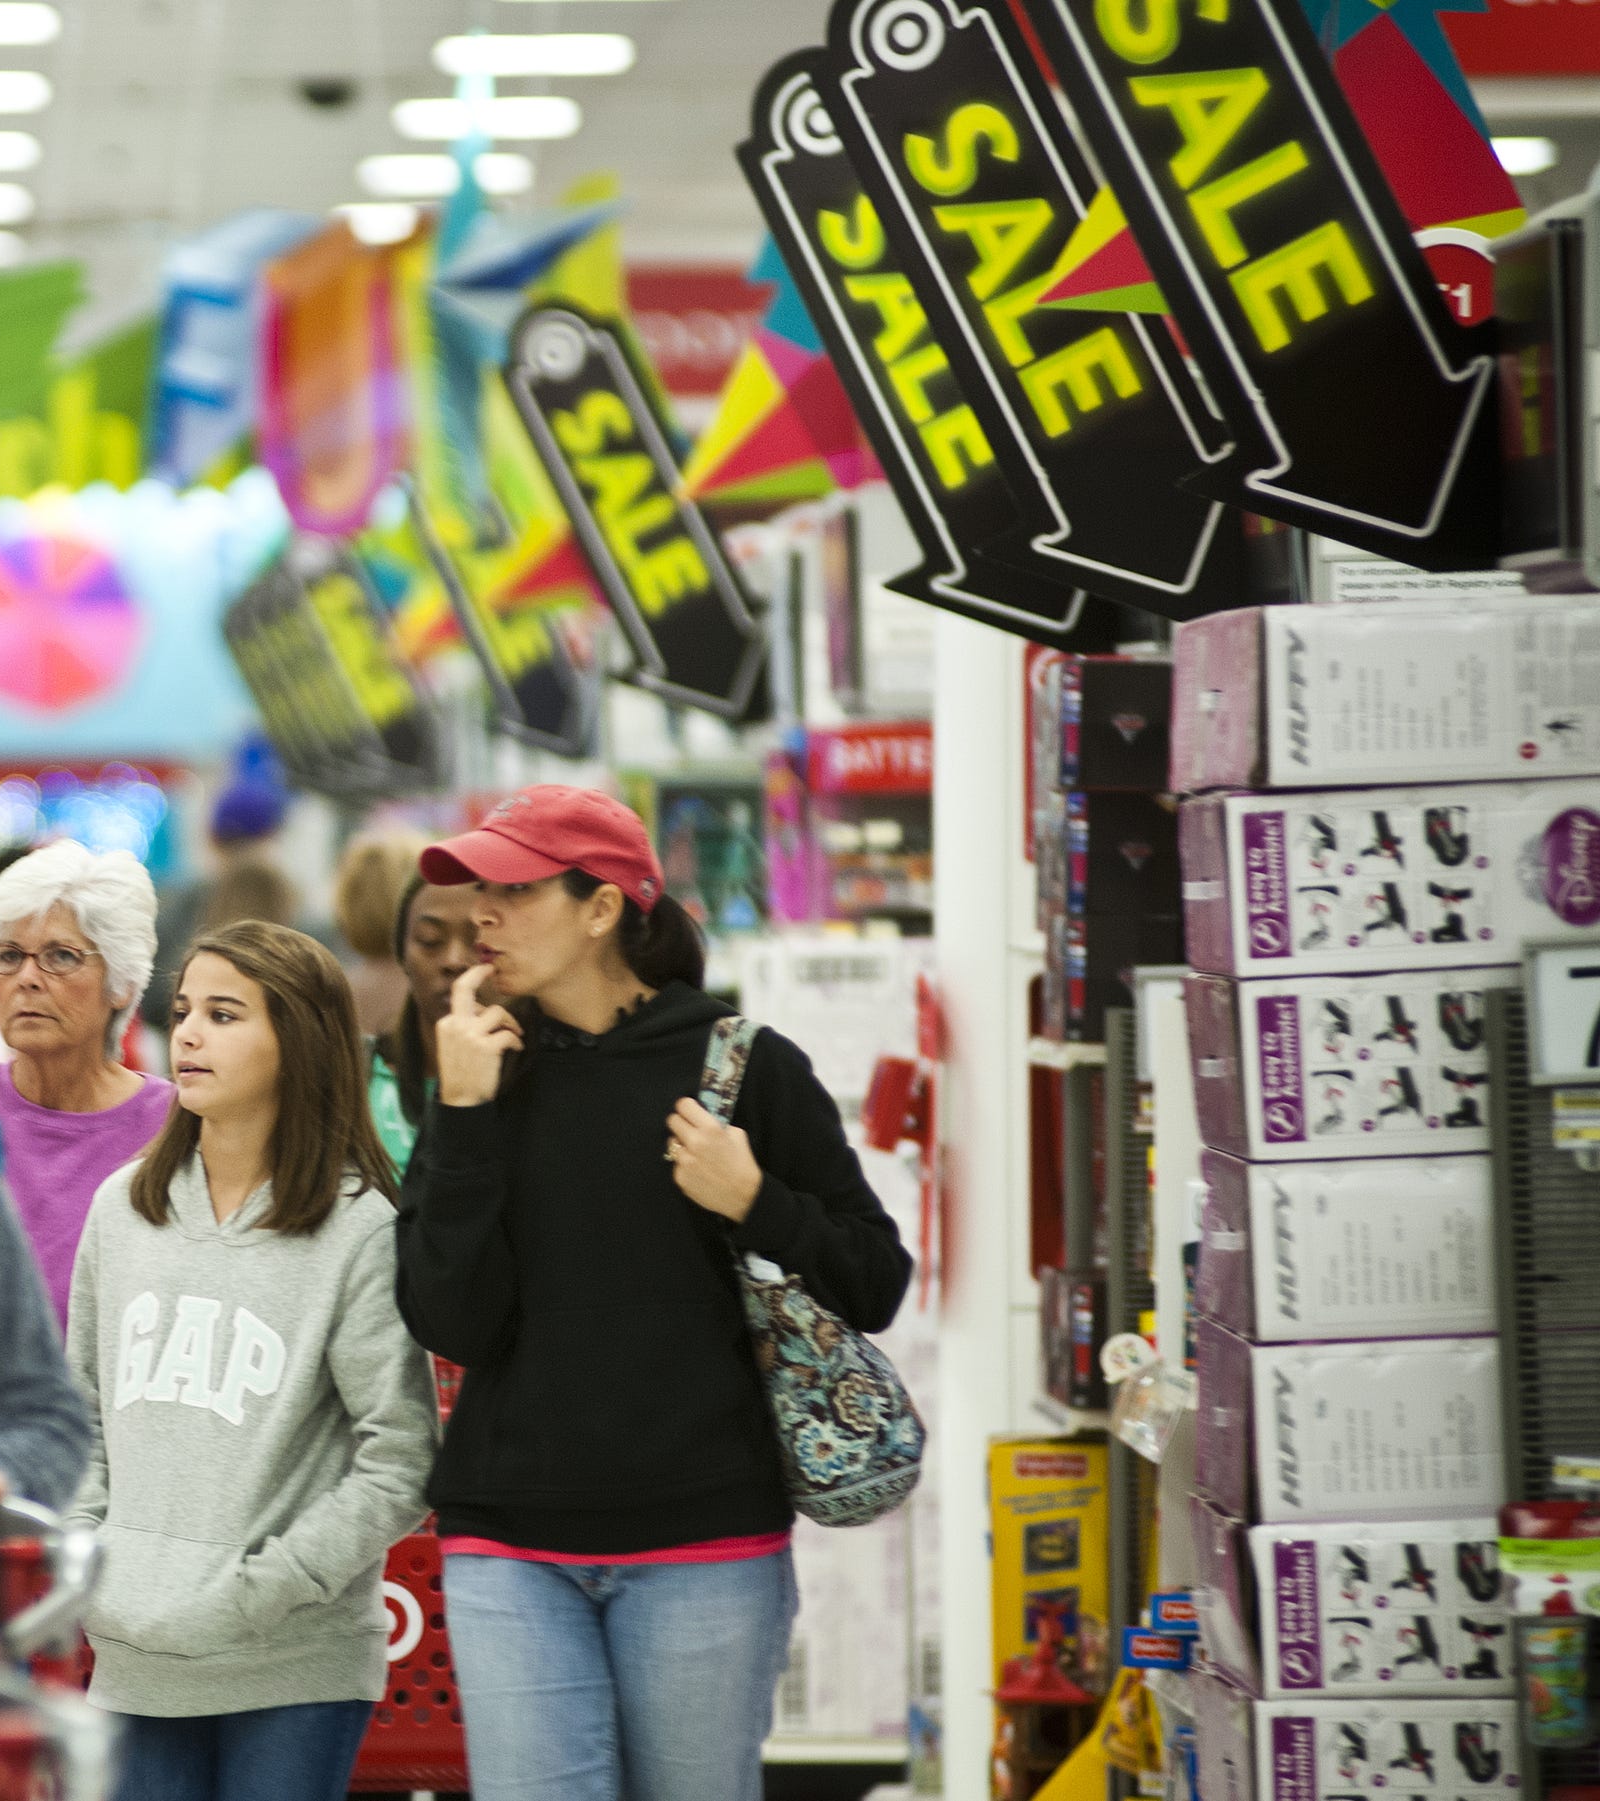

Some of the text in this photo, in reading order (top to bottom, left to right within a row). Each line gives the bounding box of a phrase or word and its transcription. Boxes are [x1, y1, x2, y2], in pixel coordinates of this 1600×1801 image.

[903, 102, 1144, 439] SALE
[552, 389, 710, 620] SALE
[1248, 847, 1267, 914] Easy to
[1260, 818, 1285, 913] Assemble!
[1262, 1031, 1281, 1098] Easy to
[1274, 1003, 1299, 1098] Assemble!
[113, 1290, 288, 1427] GAP
[1272, 1366, 1302, 1509] HUFFY
[1278, 1577, 1298, 1643] Easy to
[1292, 1548, 1317, 1644] Assemble!
